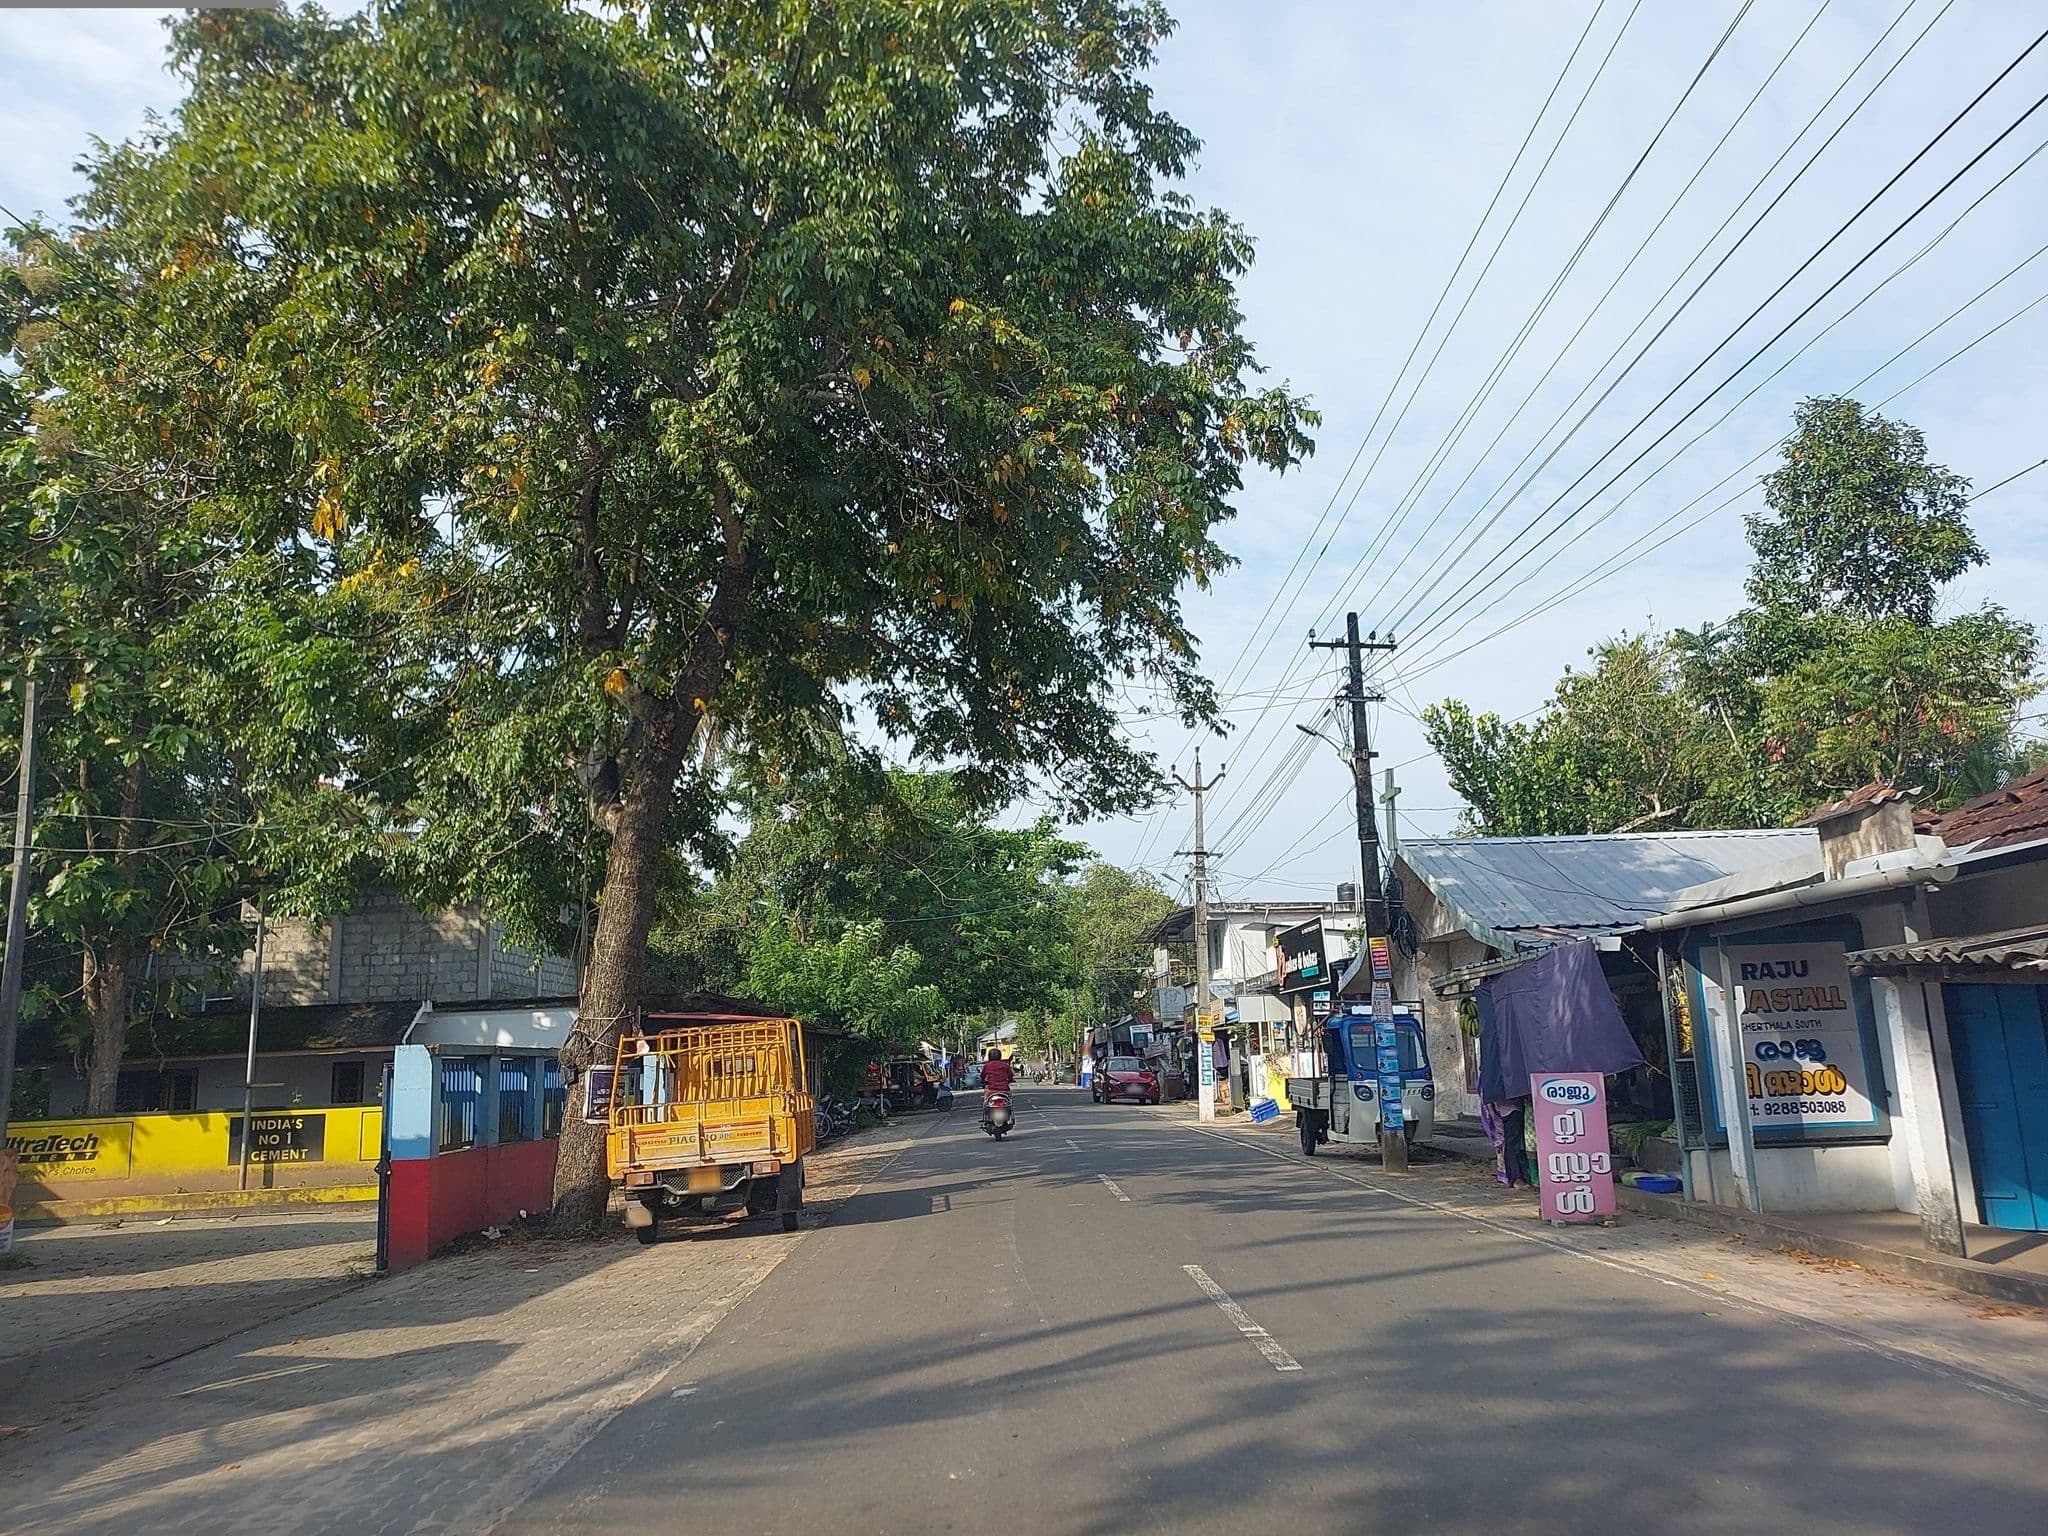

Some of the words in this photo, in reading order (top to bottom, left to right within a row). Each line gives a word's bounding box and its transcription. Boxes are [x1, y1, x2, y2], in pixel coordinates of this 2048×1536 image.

[1741, 960, 1809, 981] RAJU
[1771, 986, 1847, 1013] STALL
[1795, 1019, 1823, 1030] SOUTH
[1546, 1085, 1591, 1101] രാജു
[1764, 1100, 1846, 1116] 9288503088
[251, 1118, 304, 1131] INDIA'S
[258, 1134, 280, 1146] NO
[286, 1132, 292, 1145] 1
[250, 1148, 308, 1162] CEMENT
[63, 1165, 97, 1176] Choice
